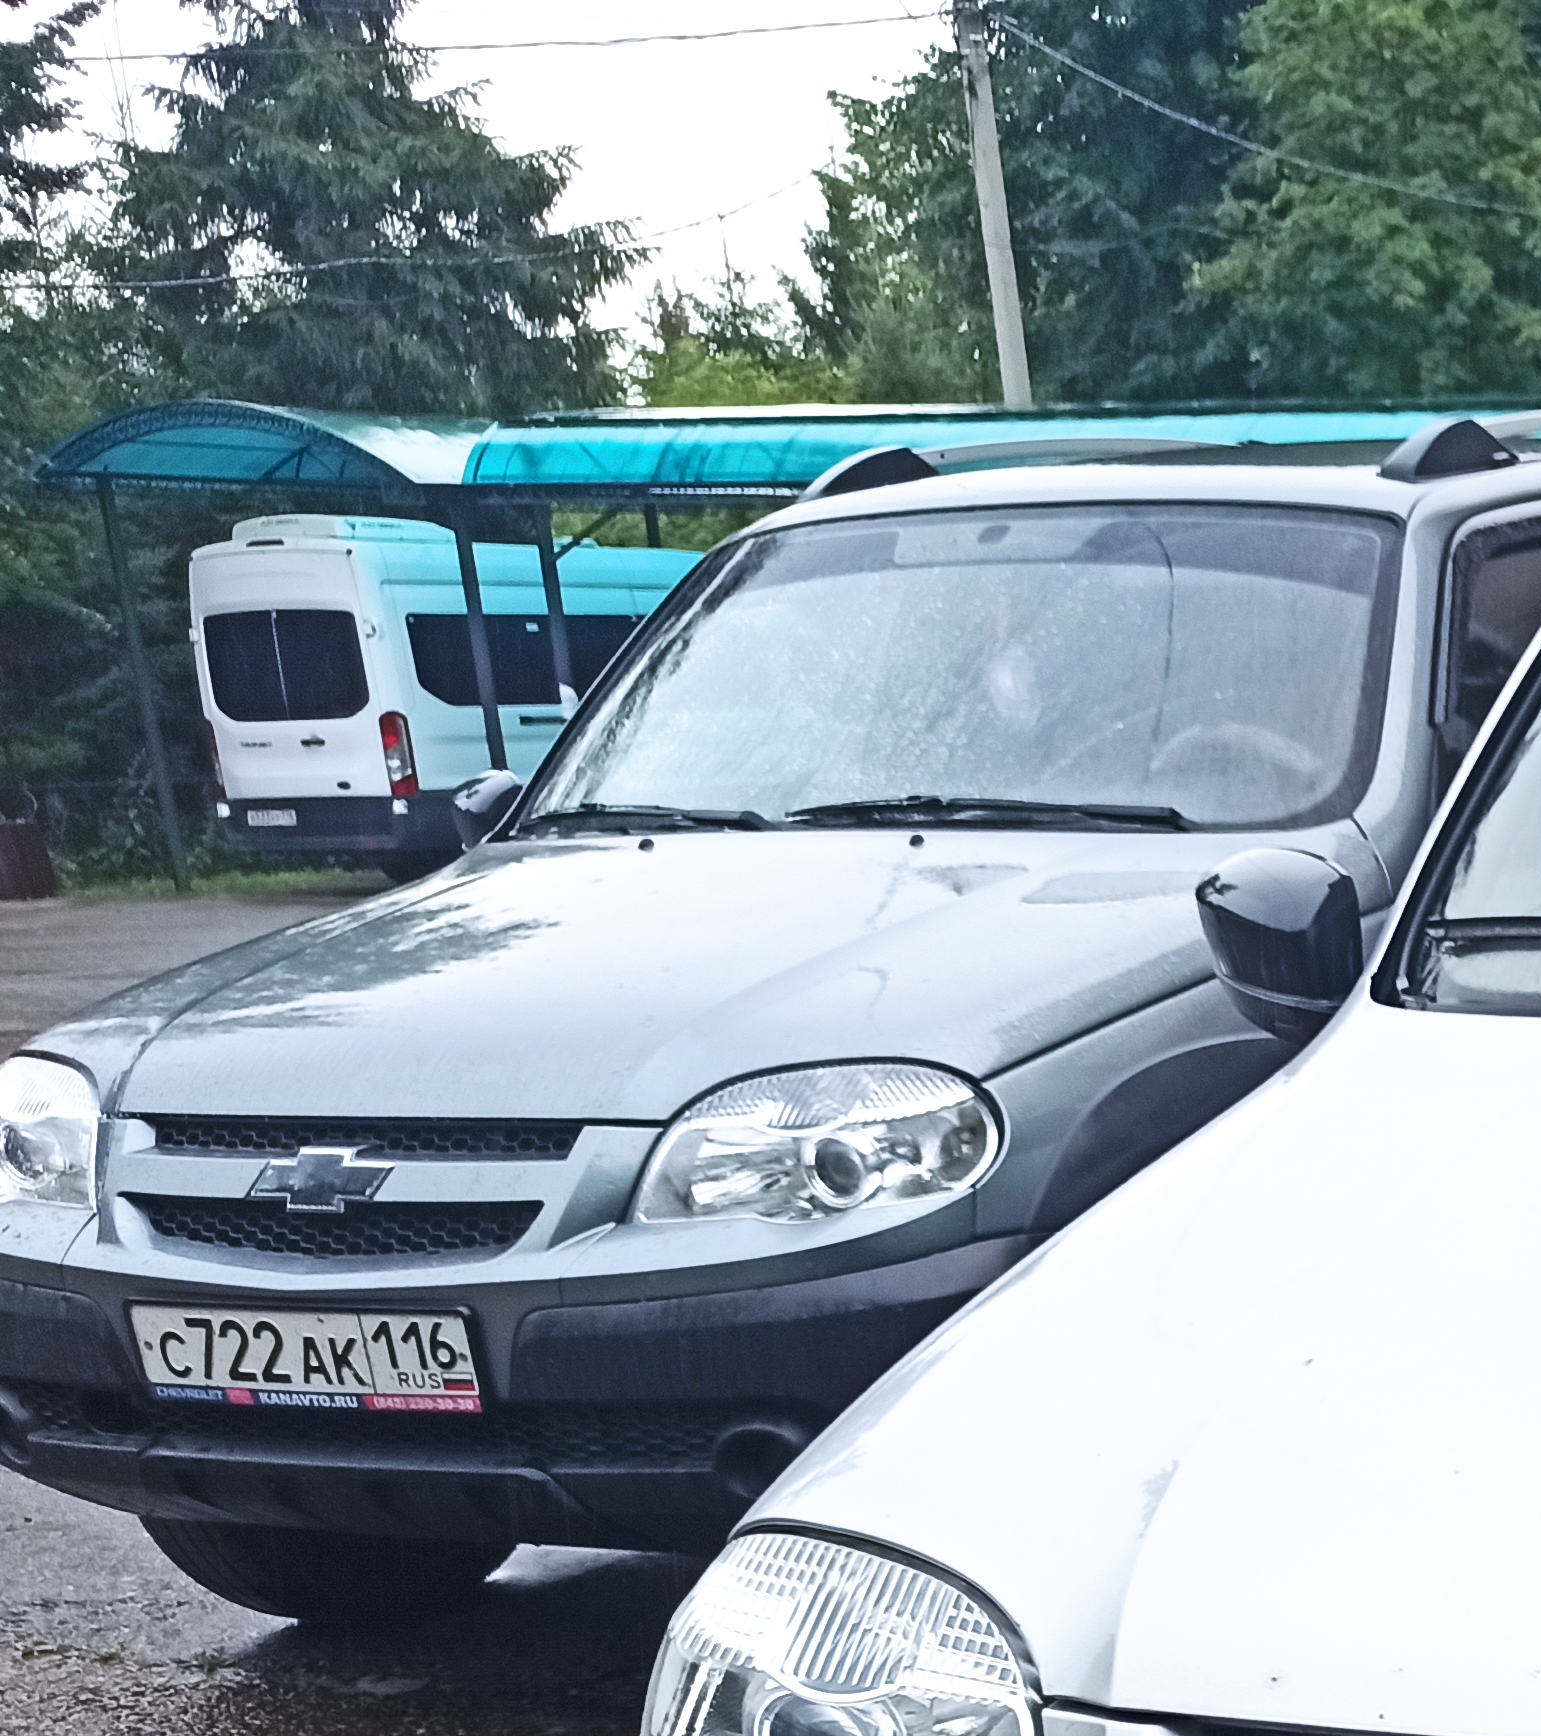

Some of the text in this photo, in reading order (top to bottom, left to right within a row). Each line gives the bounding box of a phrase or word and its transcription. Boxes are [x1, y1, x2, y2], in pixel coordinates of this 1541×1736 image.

[371, 1320, 457, 1370] 116
[398, 1372, 441, 1389] RUS
[258, 1392, 358, 1408] KANAVTO.RU
